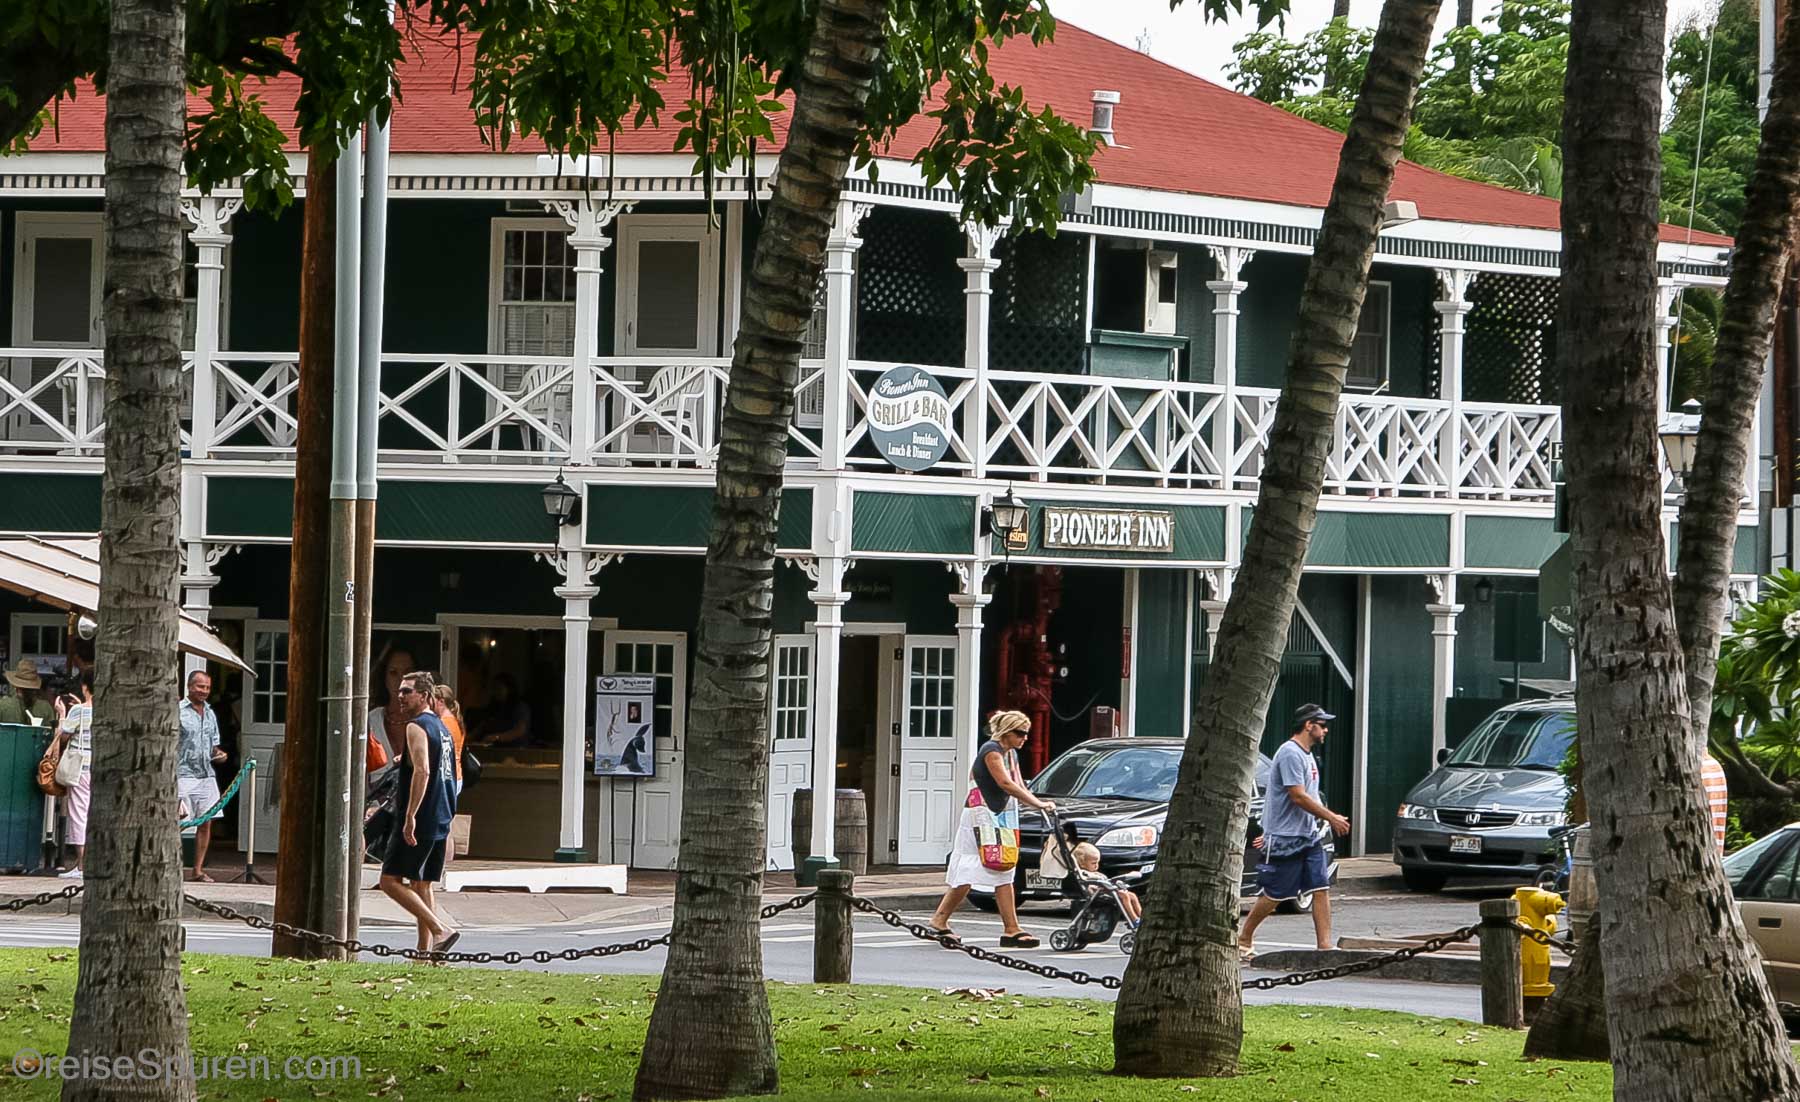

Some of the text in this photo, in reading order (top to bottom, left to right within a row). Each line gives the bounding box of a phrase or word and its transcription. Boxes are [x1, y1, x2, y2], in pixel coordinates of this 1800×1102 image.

[880, 373, 928, 395] Pioneer Inn
[873, 396, 947, 429] GRILL & BAR
[888, 442, 905, 456] Lunch
[912, 445, 931, 459] Dinner
[1048, 512, 1172, 548] PIONEER INN
